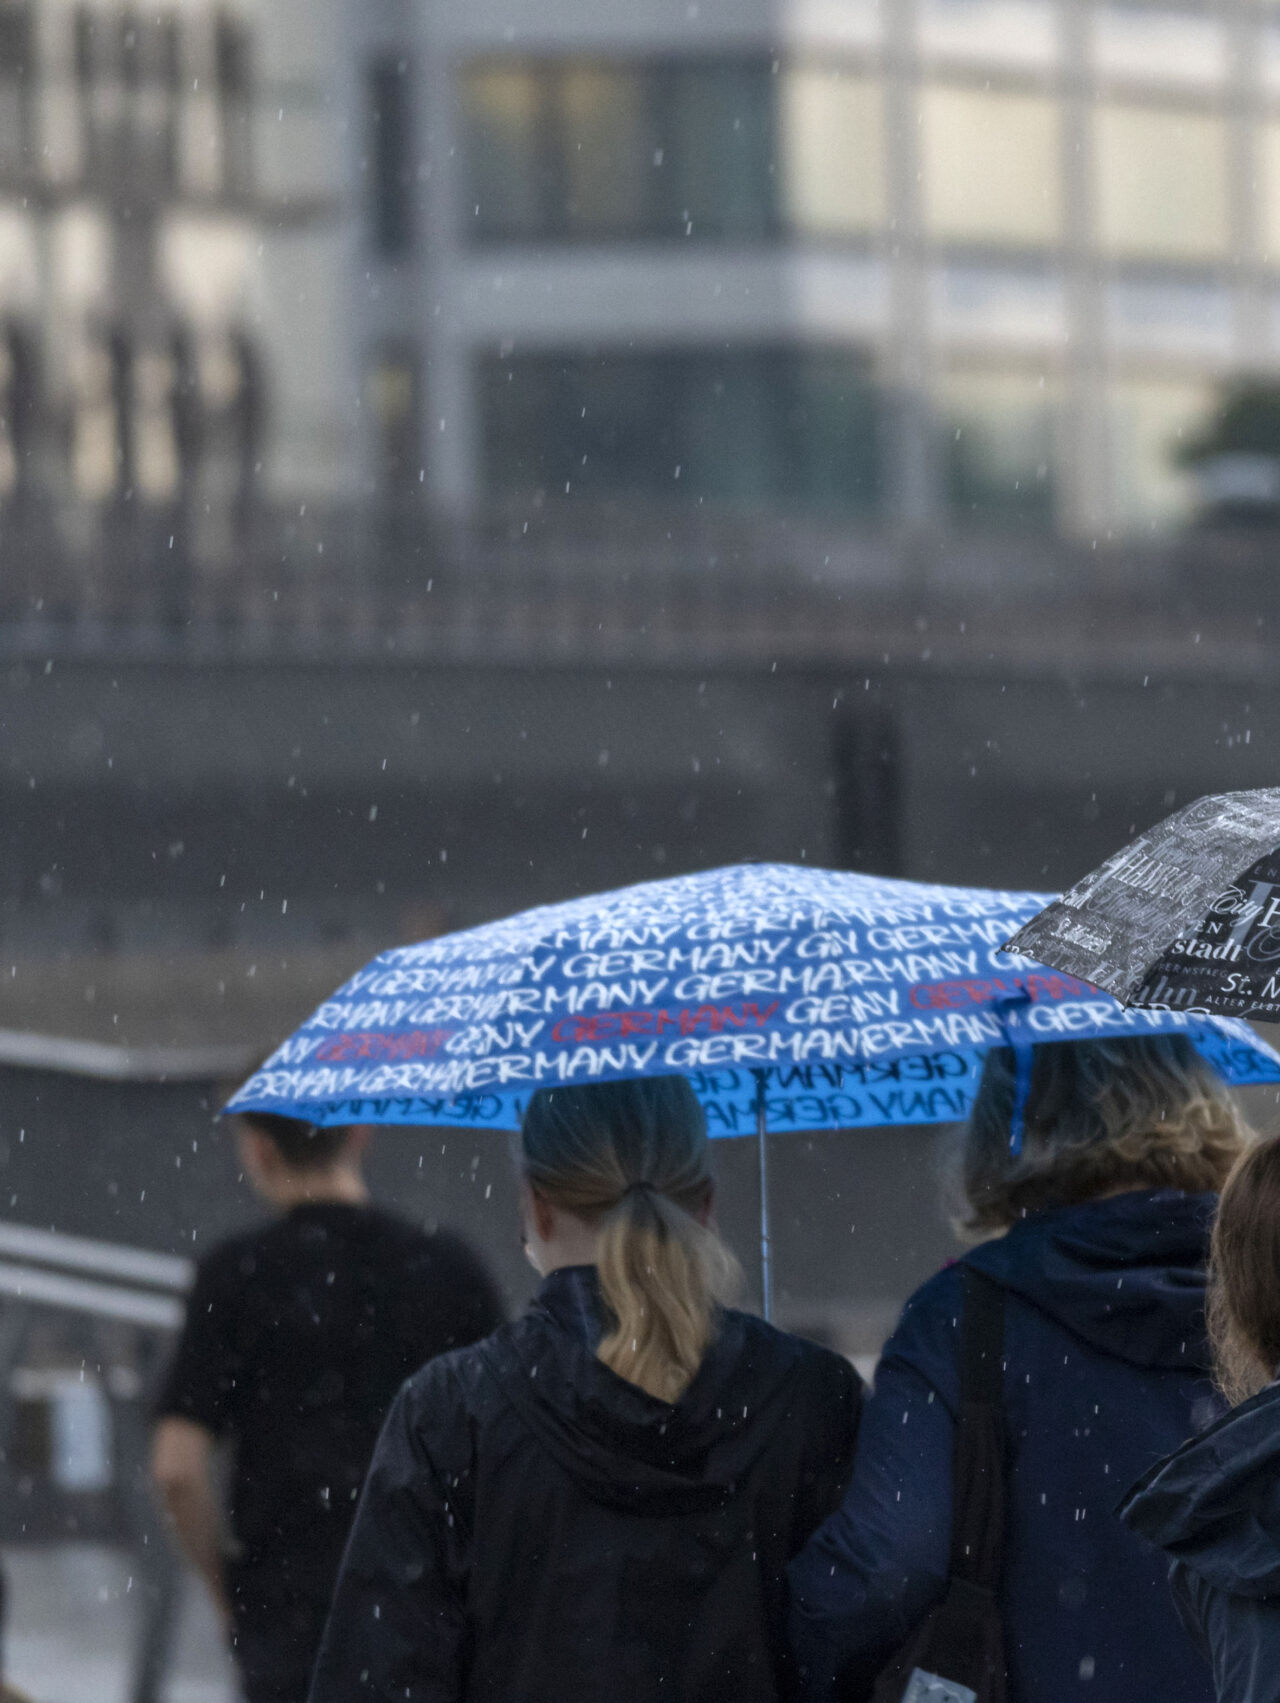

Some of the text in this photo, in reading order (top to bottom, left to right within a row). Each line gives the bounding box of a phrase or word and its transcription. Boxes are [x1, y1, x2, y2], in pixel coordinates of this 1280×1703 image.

[562, 935, 791, 979] GERMANY
[1206, 995, 1245, 1008] ALTER
[1221, 973, 1252, 995] St.
[552, 1001, 780, 1043] GERMANY
[860, 1012, 1020, 1058] ERMAN
